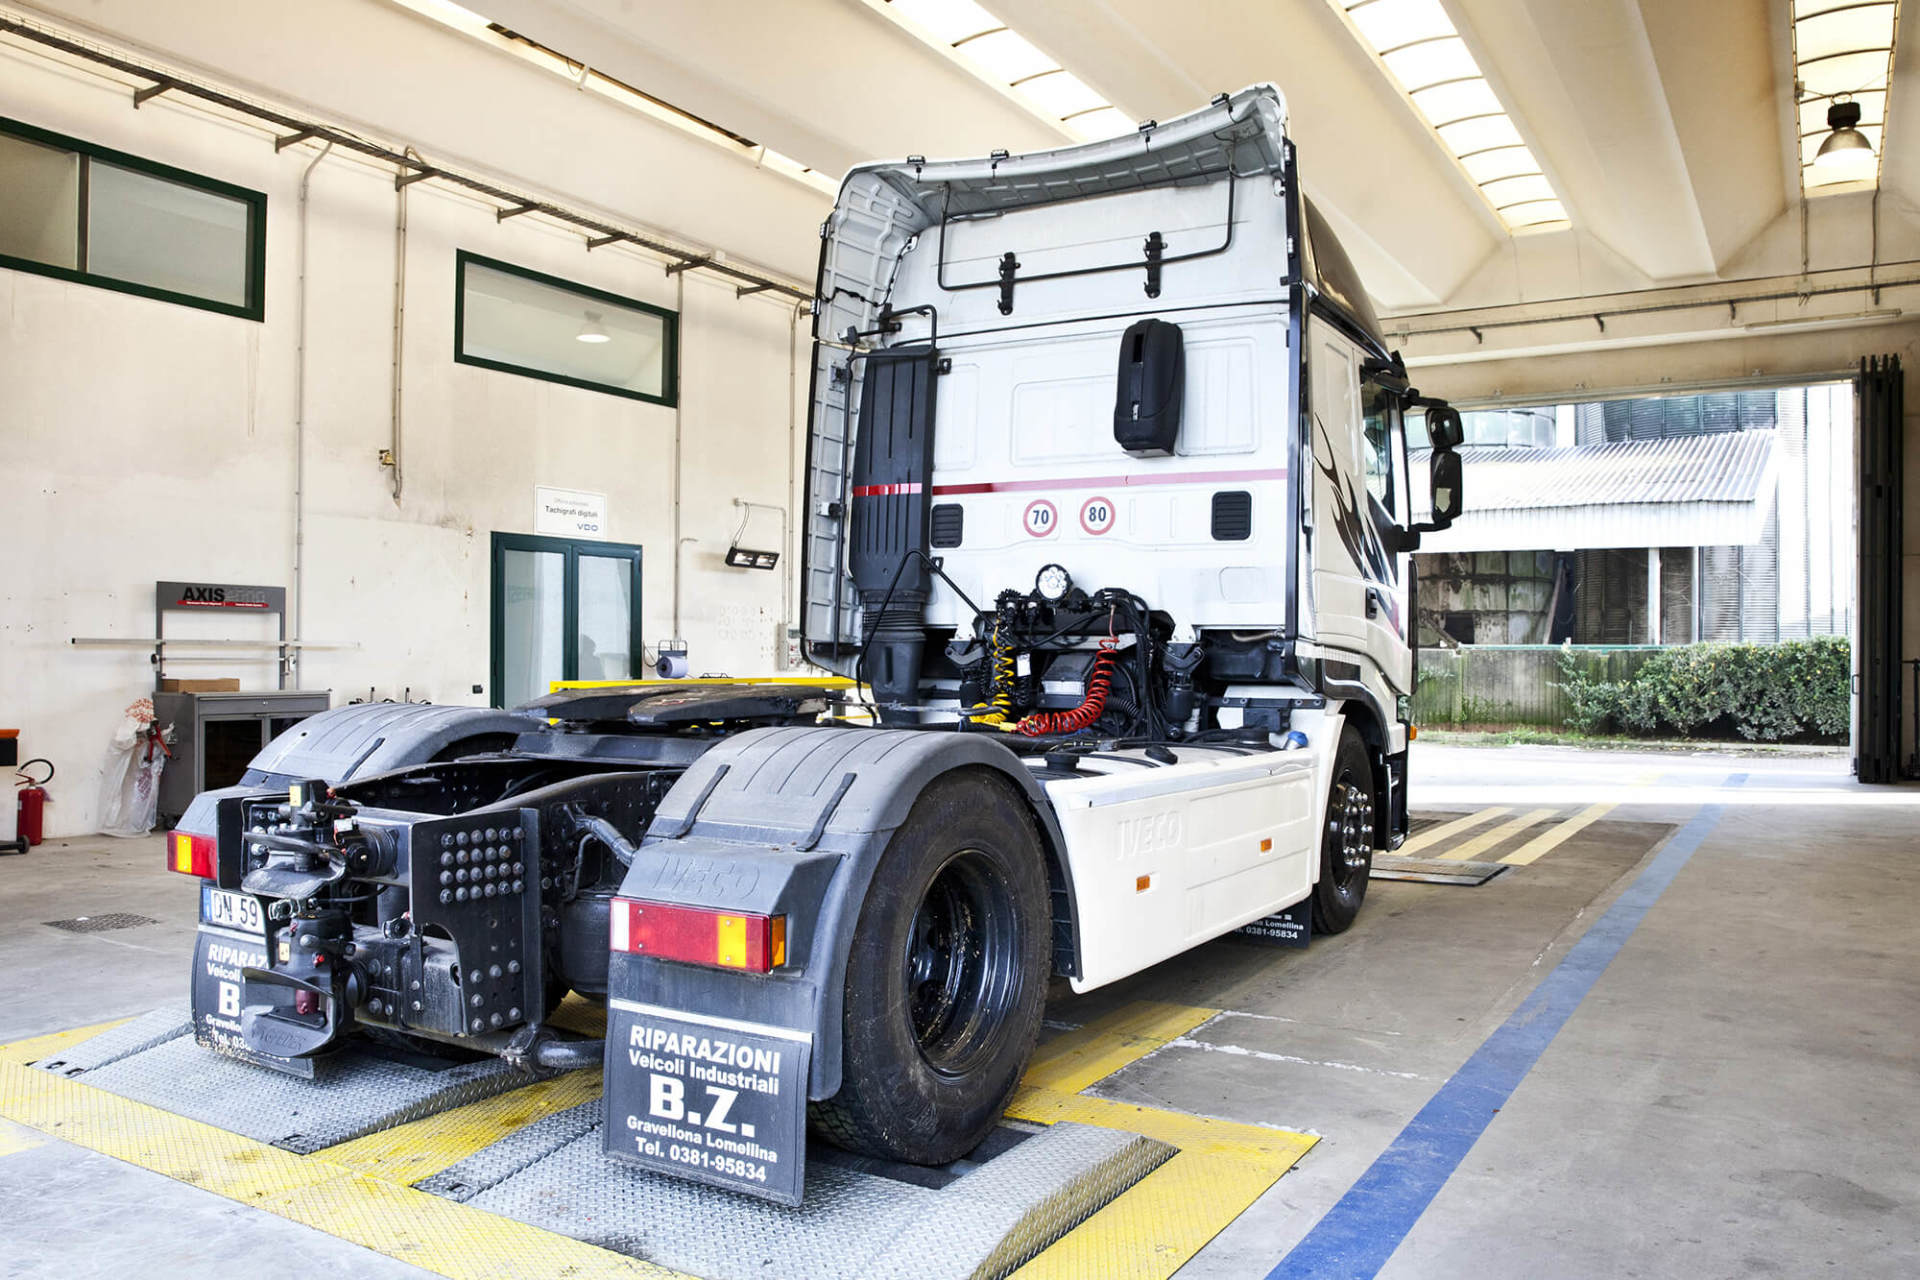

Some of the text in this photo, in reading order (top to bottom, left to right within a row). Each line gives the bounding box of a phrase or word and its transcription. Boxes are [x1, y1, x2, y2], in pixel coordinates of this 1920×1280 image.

[577, 523, 599, 532] VDO
[1033, 509, 1049, 525] 70
[1089, 506, 1106, 522] 80
[1117, 810, 1183, 861] IVECO
[213, 893, 233, 922] DN
[1246, 926, 1298, 939] 0381-95834
[1265, 920, 1304, 931] Lomellina
[208, 943, 268, 970] RIPARAZ
[206, 1013, 242, 1032] Gravello
[630, 1024, 781, 1075] RIPARAZIONI
[628, 1049, 779, 1096] Veicoli Industriali
[649, 1073, 755, 1138] B.Z.
[626, 1115, 778, 1163] Gravellona Lomellina
[635, 1136, 767, 1182] Tel. 0381-95834
